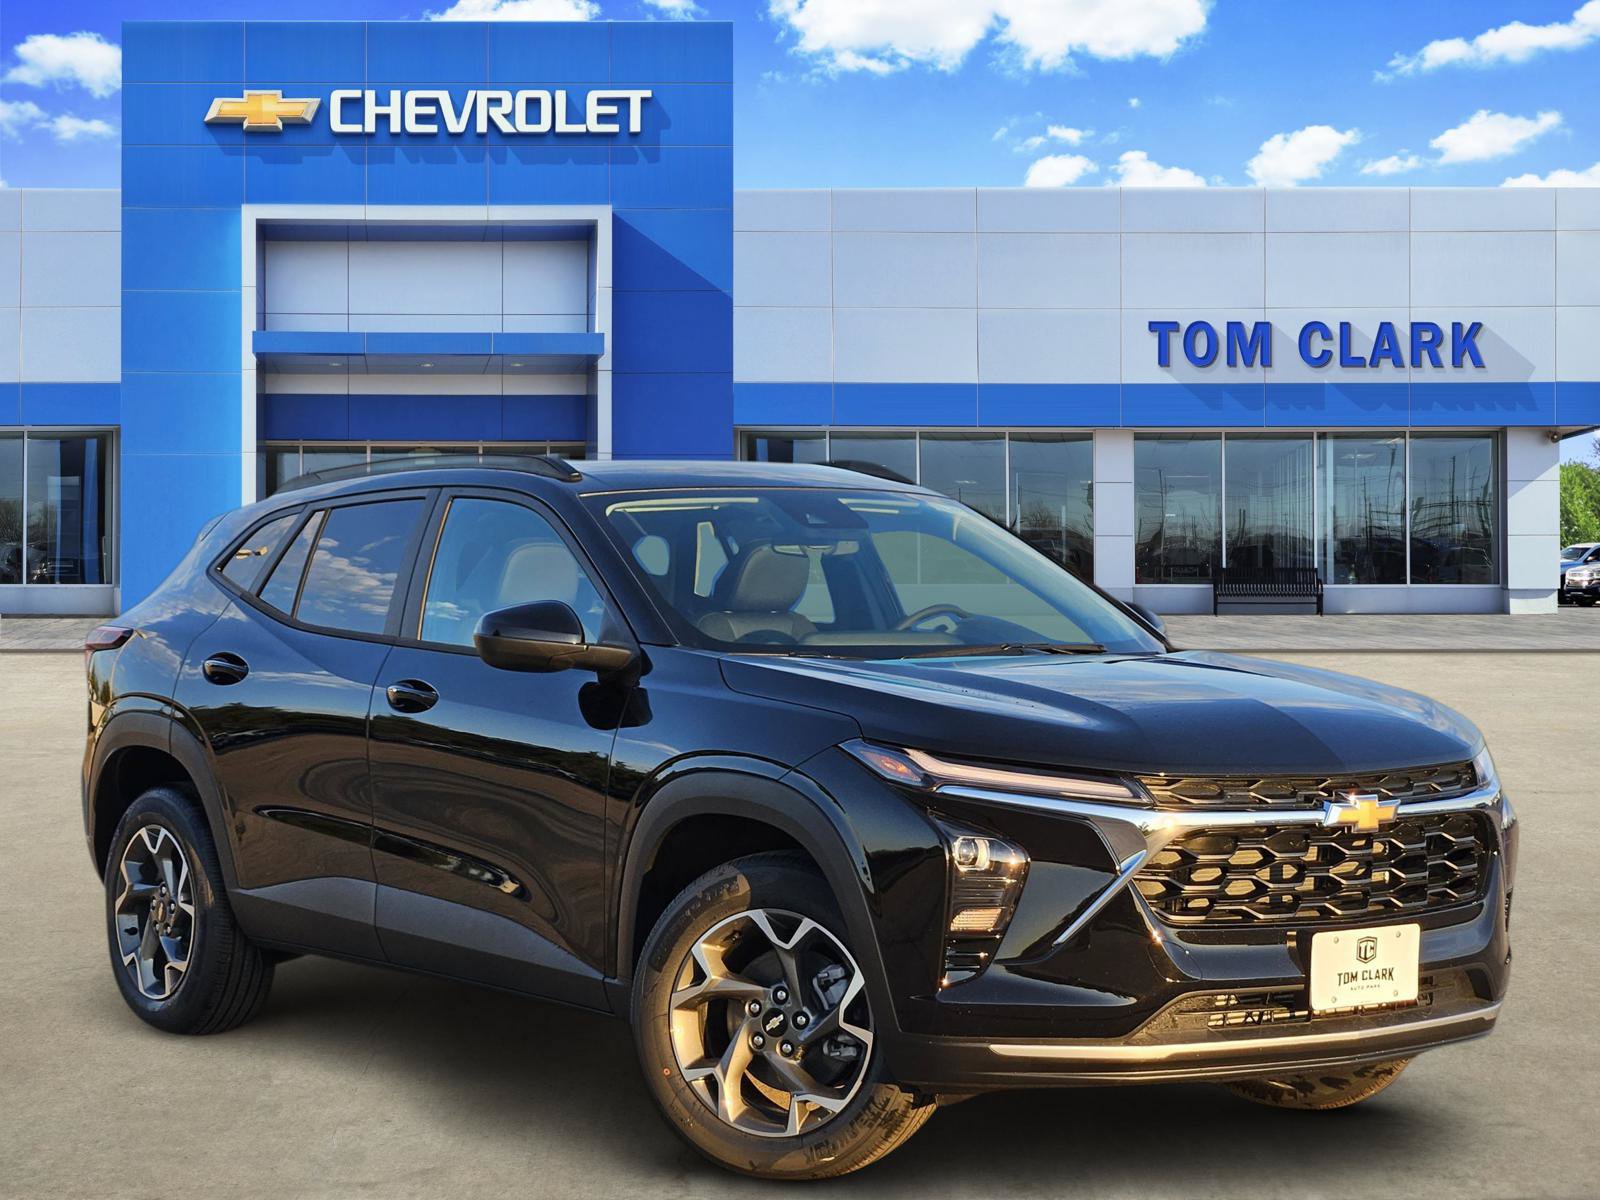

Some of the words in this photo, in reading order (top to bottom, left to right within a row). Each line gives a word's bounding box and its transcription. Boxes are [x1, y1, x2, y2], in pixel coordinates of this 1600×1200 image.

[329, 89, 652, 134] CHEVROLET
[1148, 320, 1272, 368] TOM
[1298, 320, 1486, 368] CLARK
[1337, 970, 1358, 986] TOM
[1361, 967, 1395, 981] CLARK
